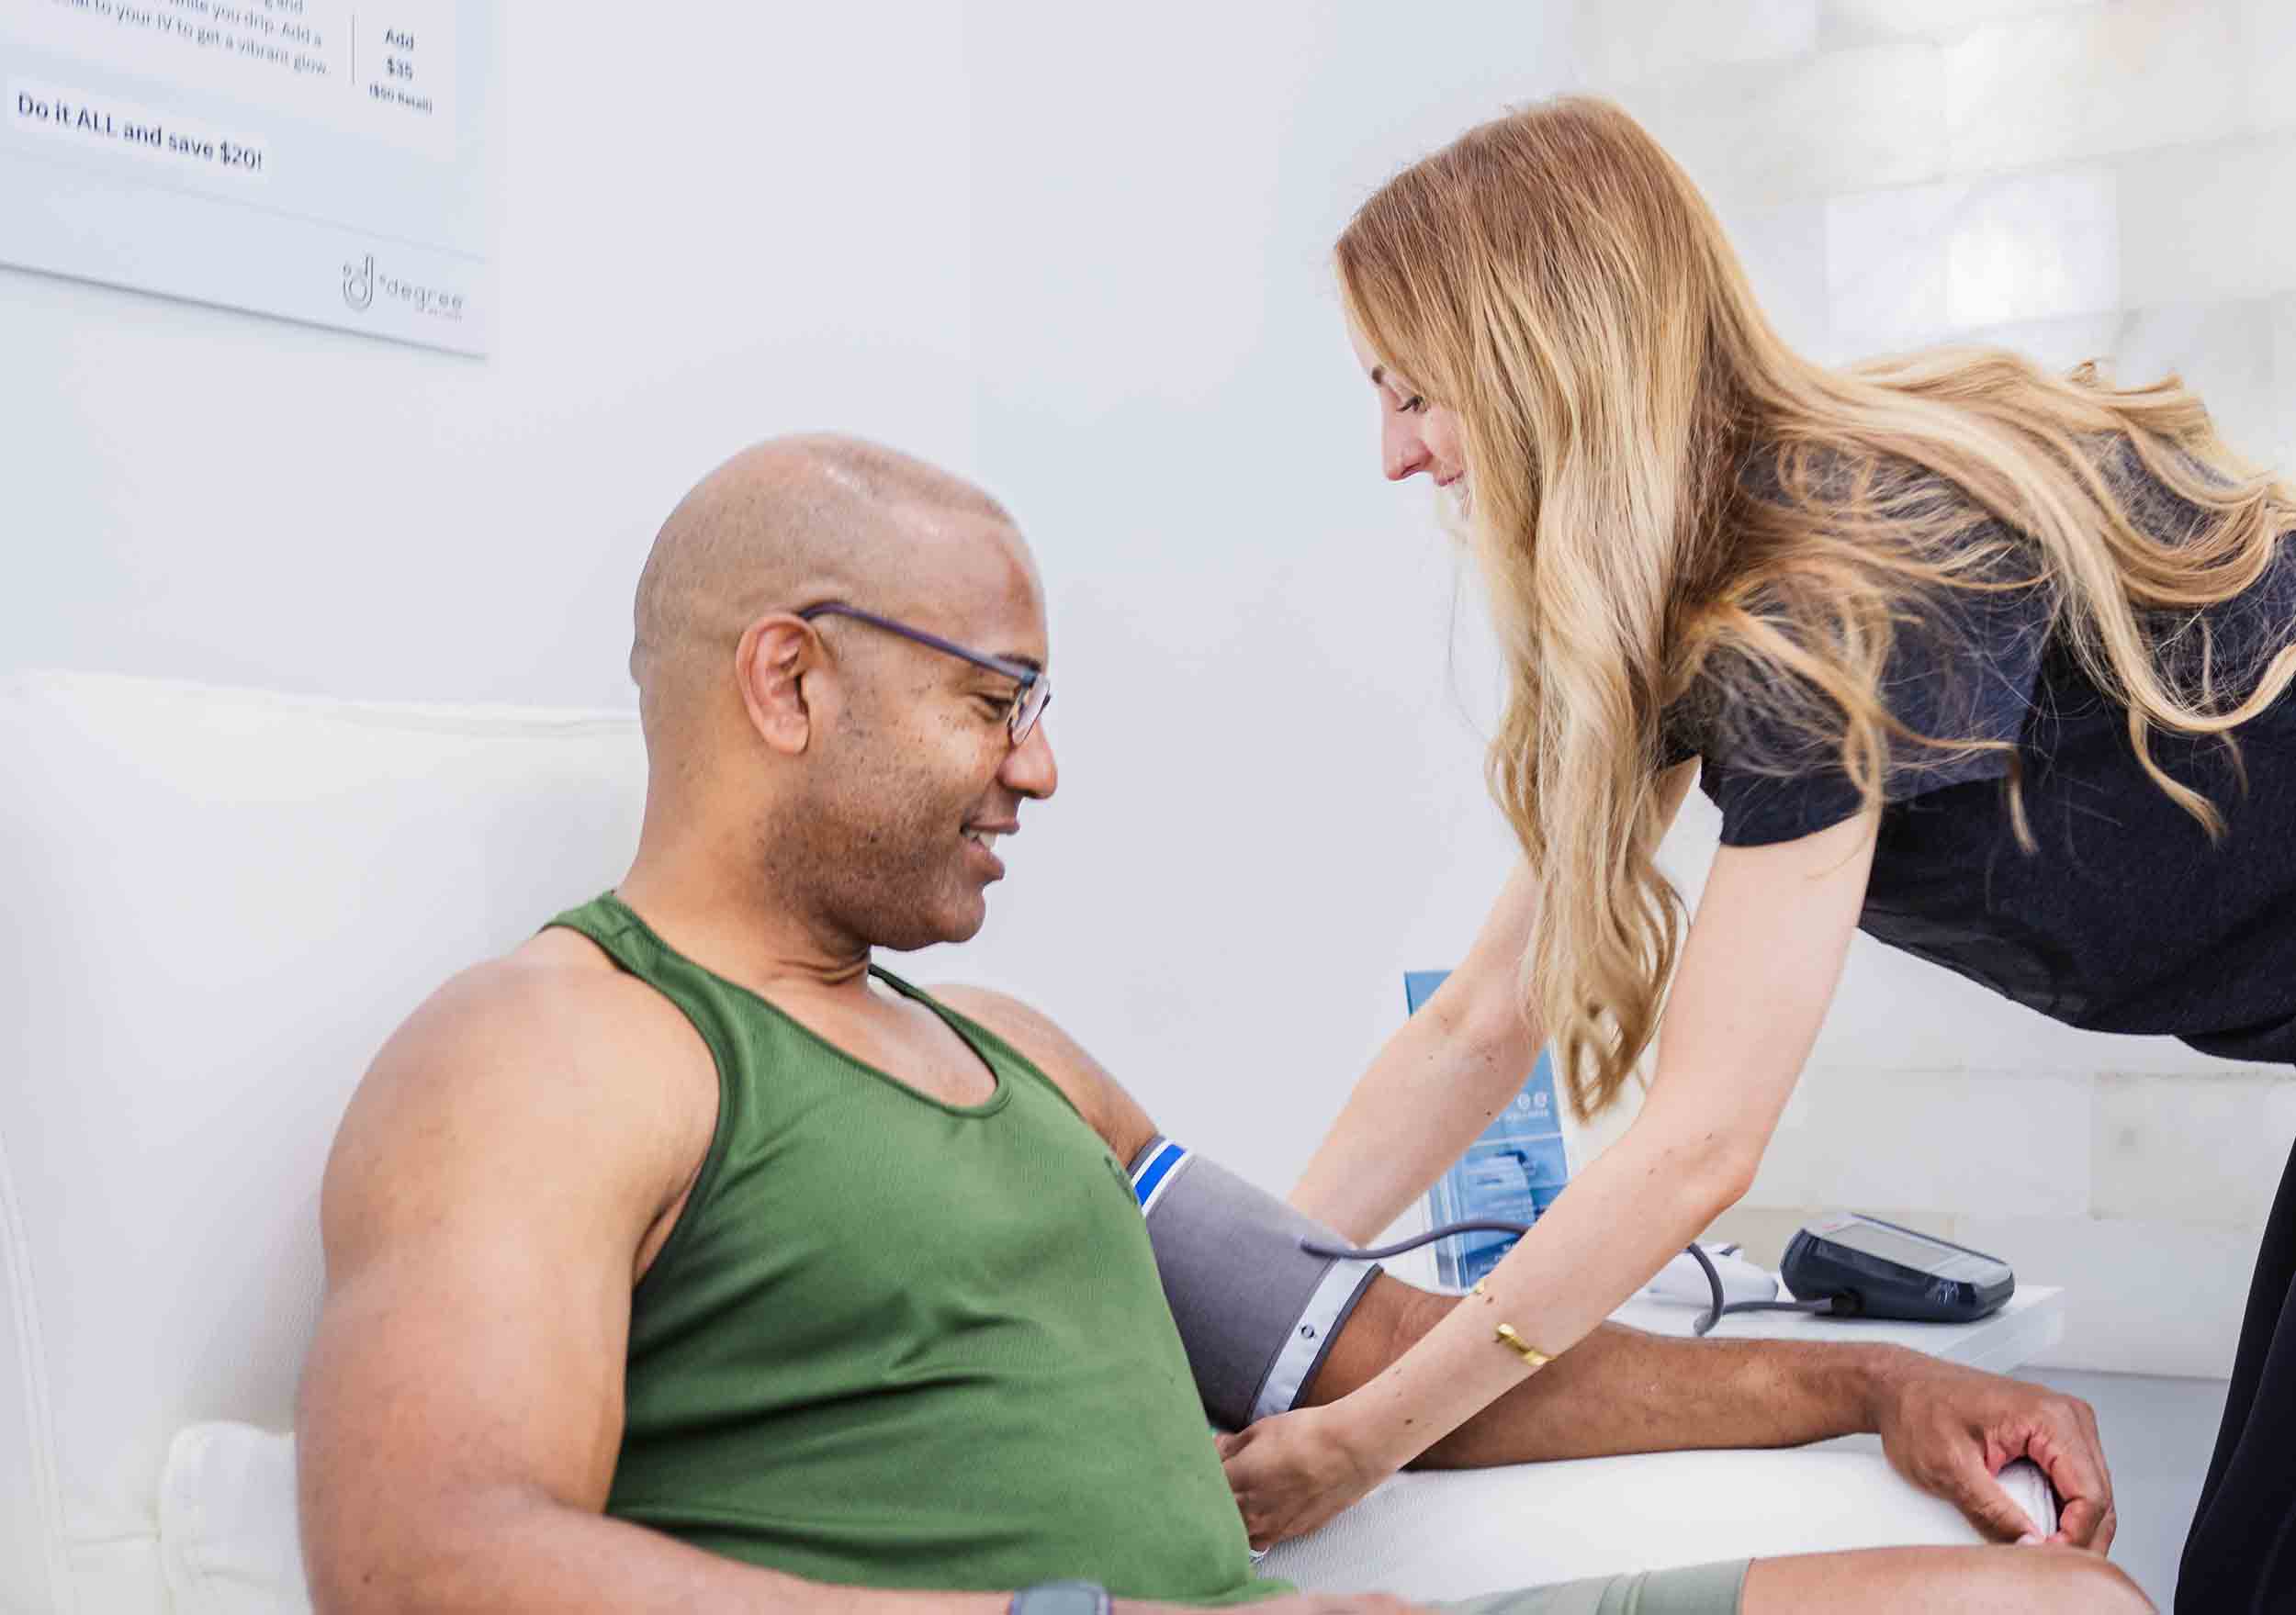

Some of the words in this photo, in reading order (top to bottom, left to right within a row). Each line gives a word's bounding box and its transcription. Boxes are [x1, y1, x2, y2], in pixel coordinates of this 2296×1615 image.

[116, 6, 152, 27] your
[176, 20, 193, 38] to
[197, 28, 220, 47] get
[225, 36, 234, 50] a
[238, 39, 289, 66] vibrant
[212, 6, 240, 24] you
[314, 36, 323, 50] a
[383, 27, 414, 51] Add
[384, 56, 412, 82] $35
[18, 91, 49, 118] Do
[55, 98, 71, 127] it
[76, 107, 117, 138] ALL
[124, 124, 161, 148] and
[168, 132, 213, 161] save
[219, 140, 261, 171] $20!
